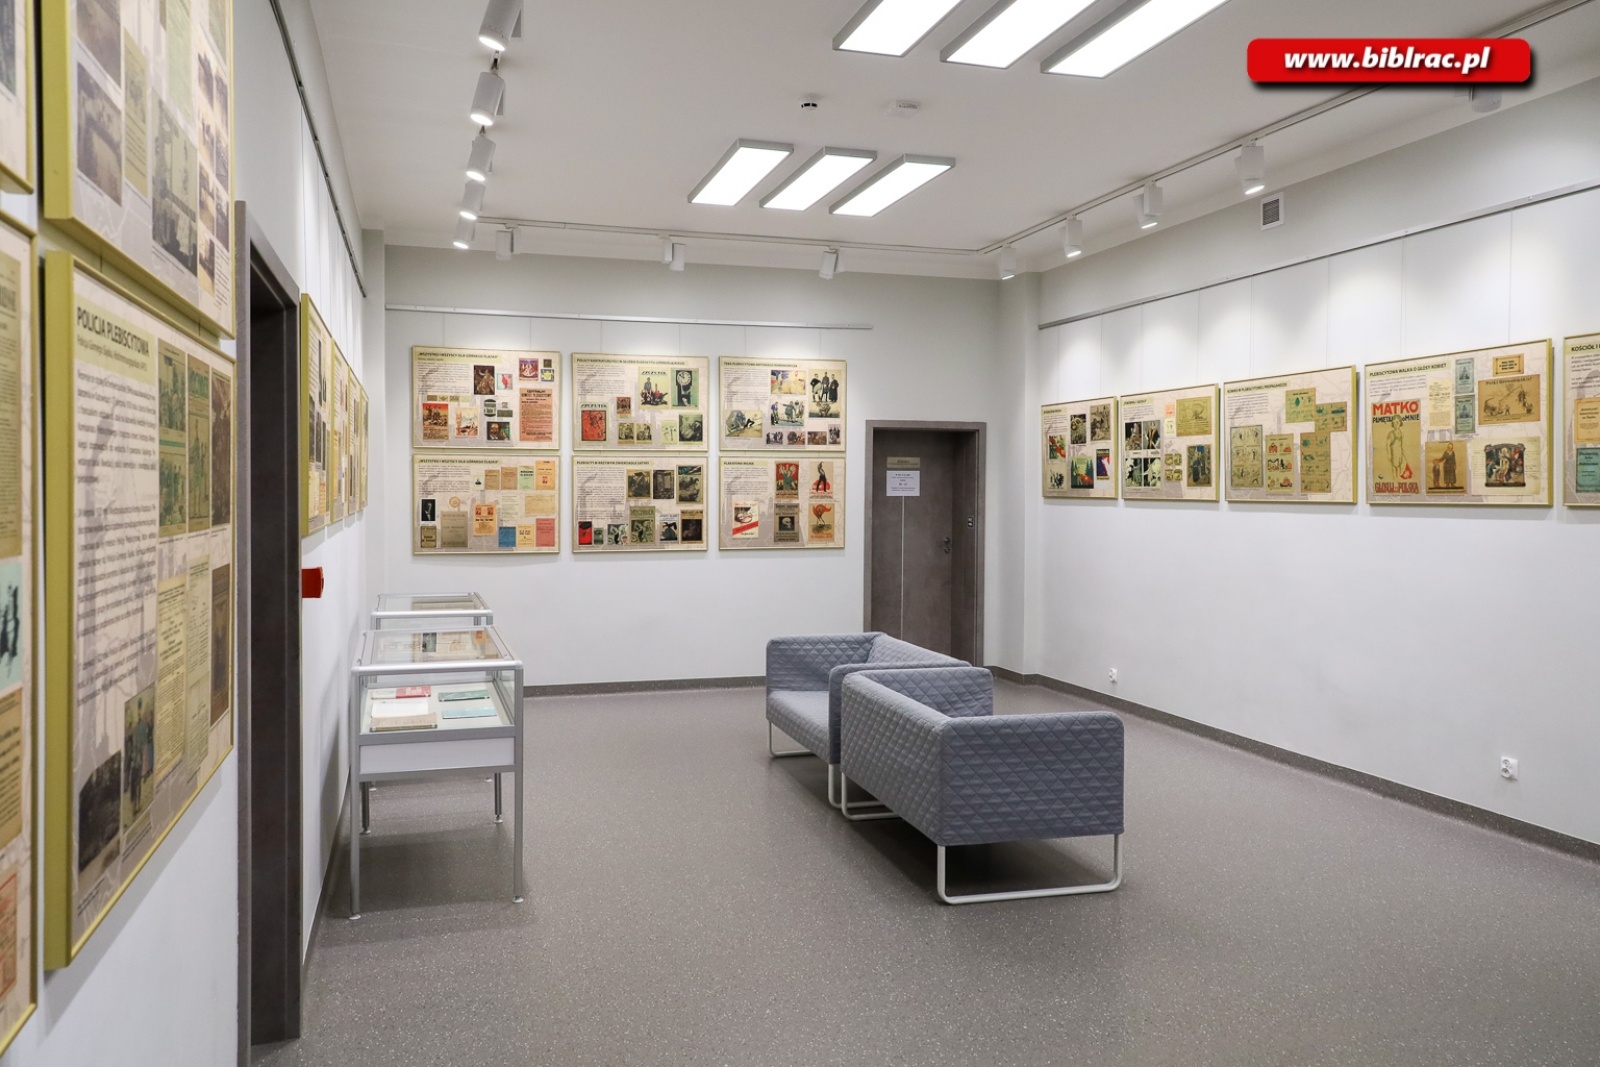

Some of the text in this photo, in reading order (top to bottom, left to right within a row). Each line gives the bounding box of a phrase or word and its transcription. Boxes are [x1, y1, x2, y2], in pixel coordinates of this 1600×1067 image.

[77, 306, 150, 358] POLICJA PLEBISCYTOWA
[1369, 369, 1398, 377] PLEBISCYTOWA
[1372, 400, 1419, 416] MATKO
